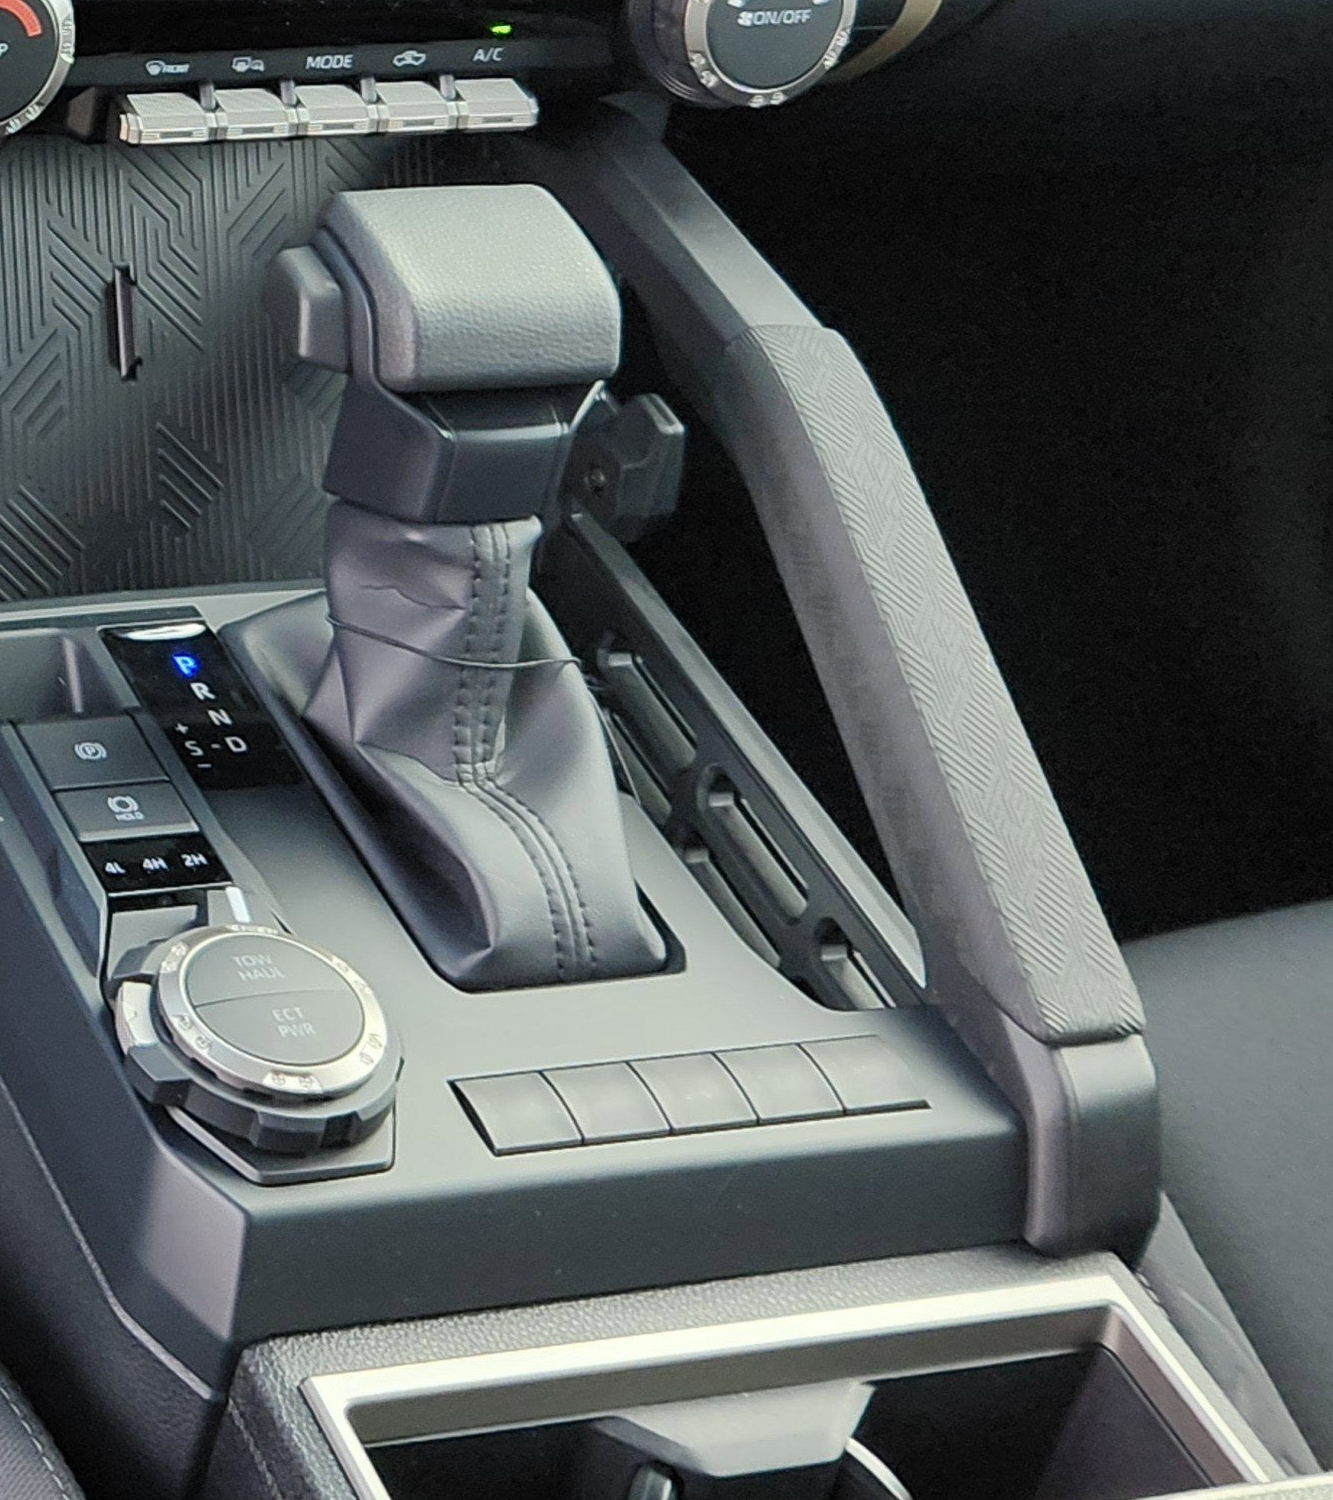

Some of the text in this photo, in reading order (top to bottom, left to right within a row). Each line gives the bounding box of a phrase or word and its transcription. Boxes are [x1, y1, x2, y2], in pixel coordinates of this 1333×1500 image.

[752, 9, 812, 26] ON/OFF
[306, 55, 355, 71] MODE
[473, 47, 505, 63] A/C
[173, 653, 199, 678] P
[190, 682, 216, 701] R
[208, 708, 233, 726] N
[185, 736, 248, 756] S D
[104, 852, 209, 875] 4L 4H 2H
[233, 953, 274, 967] TOW
[238, 965, 286, 981] HAUL
[271, 1006, 306, 1023] ECT
[277, 1023, 317, 1039] PWR
